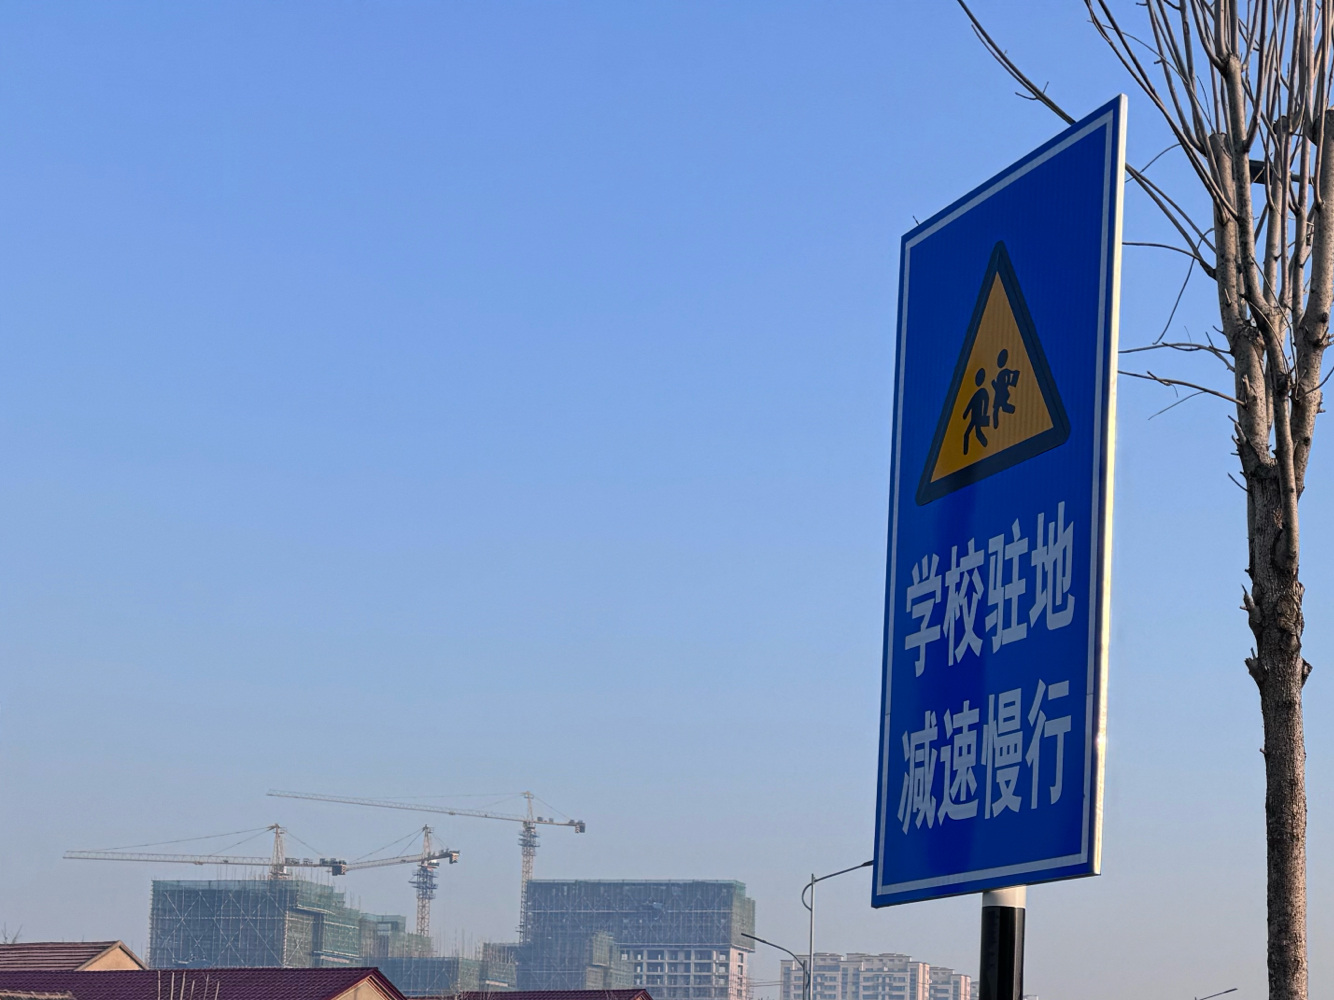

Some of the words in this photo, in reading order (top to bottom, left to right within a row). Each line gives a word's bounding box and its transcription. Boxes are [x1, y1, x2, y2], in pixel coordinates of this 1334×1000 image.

[905, 501, 1075, 677] 学校驻地
[897, 679, 1072, 834] 减速慢行
